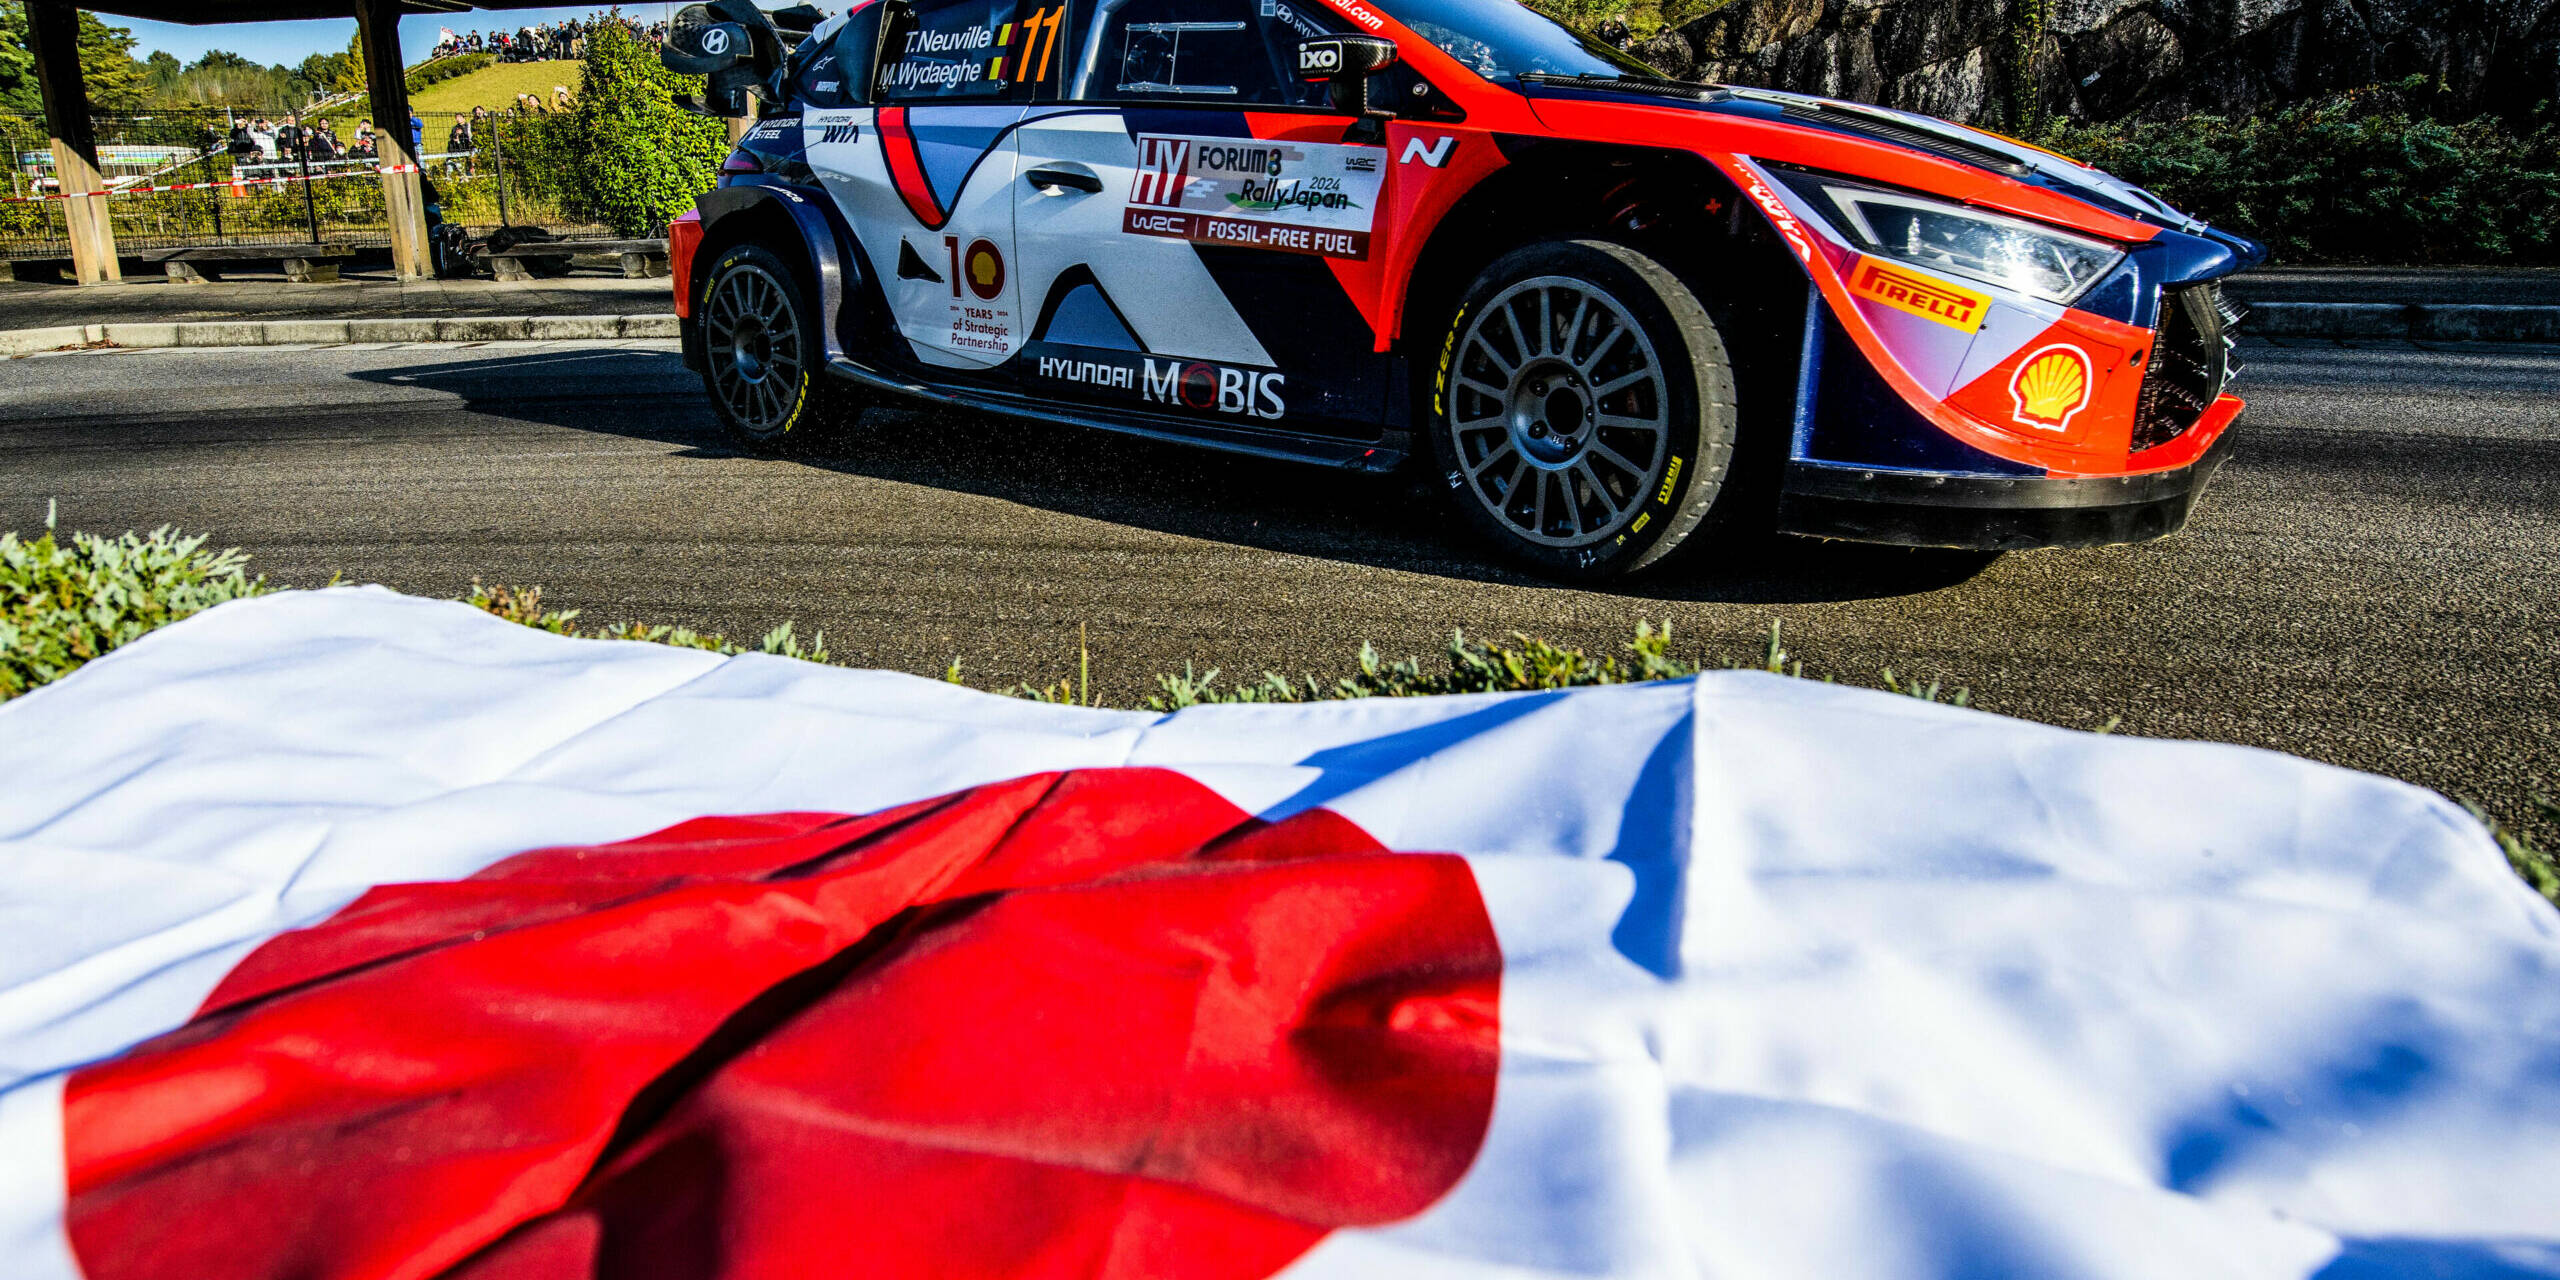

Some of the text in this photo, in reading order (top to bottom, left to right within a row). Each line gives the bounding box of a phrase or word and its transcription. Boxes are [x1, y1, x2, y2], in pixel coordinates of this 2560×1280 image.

[905, 25, 991, 53] T.Neuville
[1016, 6, 1063, 82] 11
[1299, 43, 1338, 69] ixo
[880, 59, 981, 90] M.Wydaeghe
[755, 129, 781, 139] STEEL
[822, 121, 859, 144] WIA
[1198, 146, 1282, 176] FORUM8
[1399, 136, 1458, 168] N
[1309, 176, 1341, 191] 2024
[1132, 213, 1186, 233] WRC
[1207, 220, 1357, 255] FOSSIL-FREE FUEL
[944, 234, 1006, 301] 10
[1859, 265, 1977, 324] PIRELLI
[965, 307, 993, 320] YEARS
[951, 332, 1009, 353] Partnership
[953, 318, 1009, 339] of Strategic
[1039, 356, 1286, 420] HYUNDAI MOBIS
